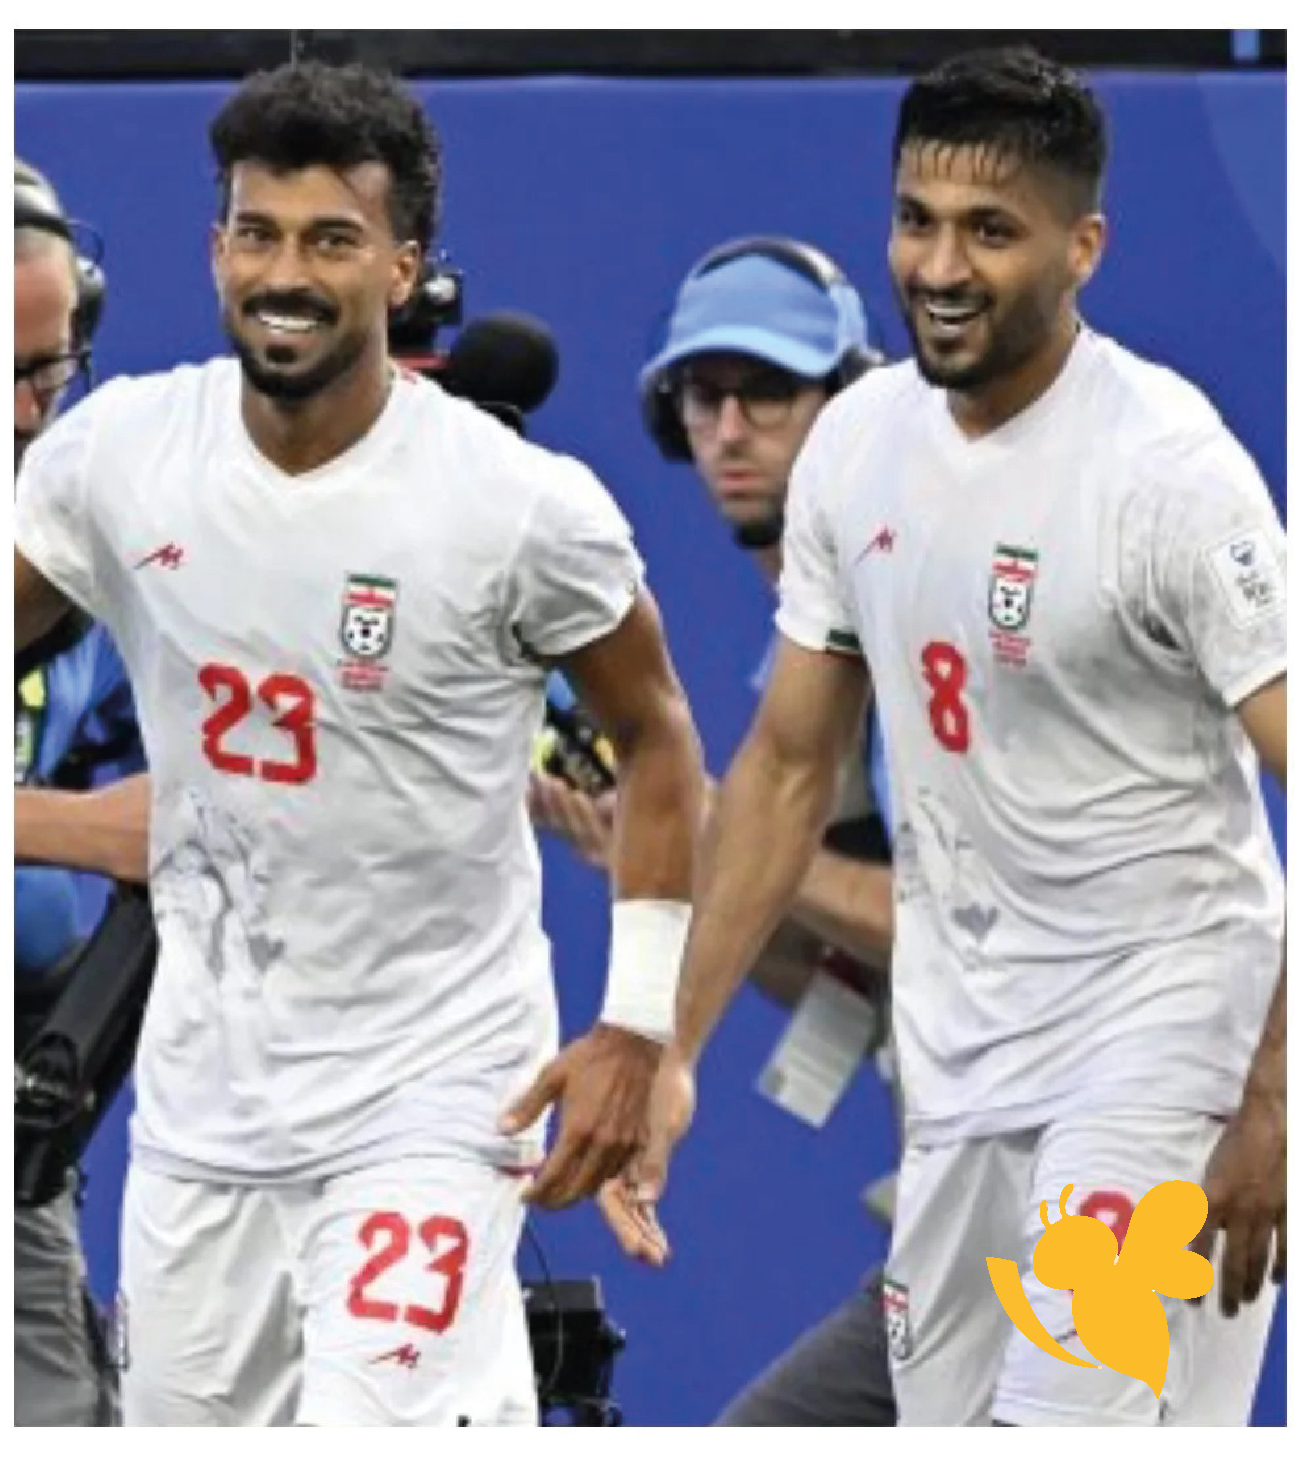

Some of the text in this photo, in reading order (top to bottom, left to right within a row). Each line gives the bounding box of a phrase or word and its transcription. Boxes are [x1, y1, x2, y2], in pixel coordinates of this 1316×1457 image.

[198, 661, 318, 786] 23
[924, 640, 972, 753] 8
[347, 1210, 470, 1334] 23
